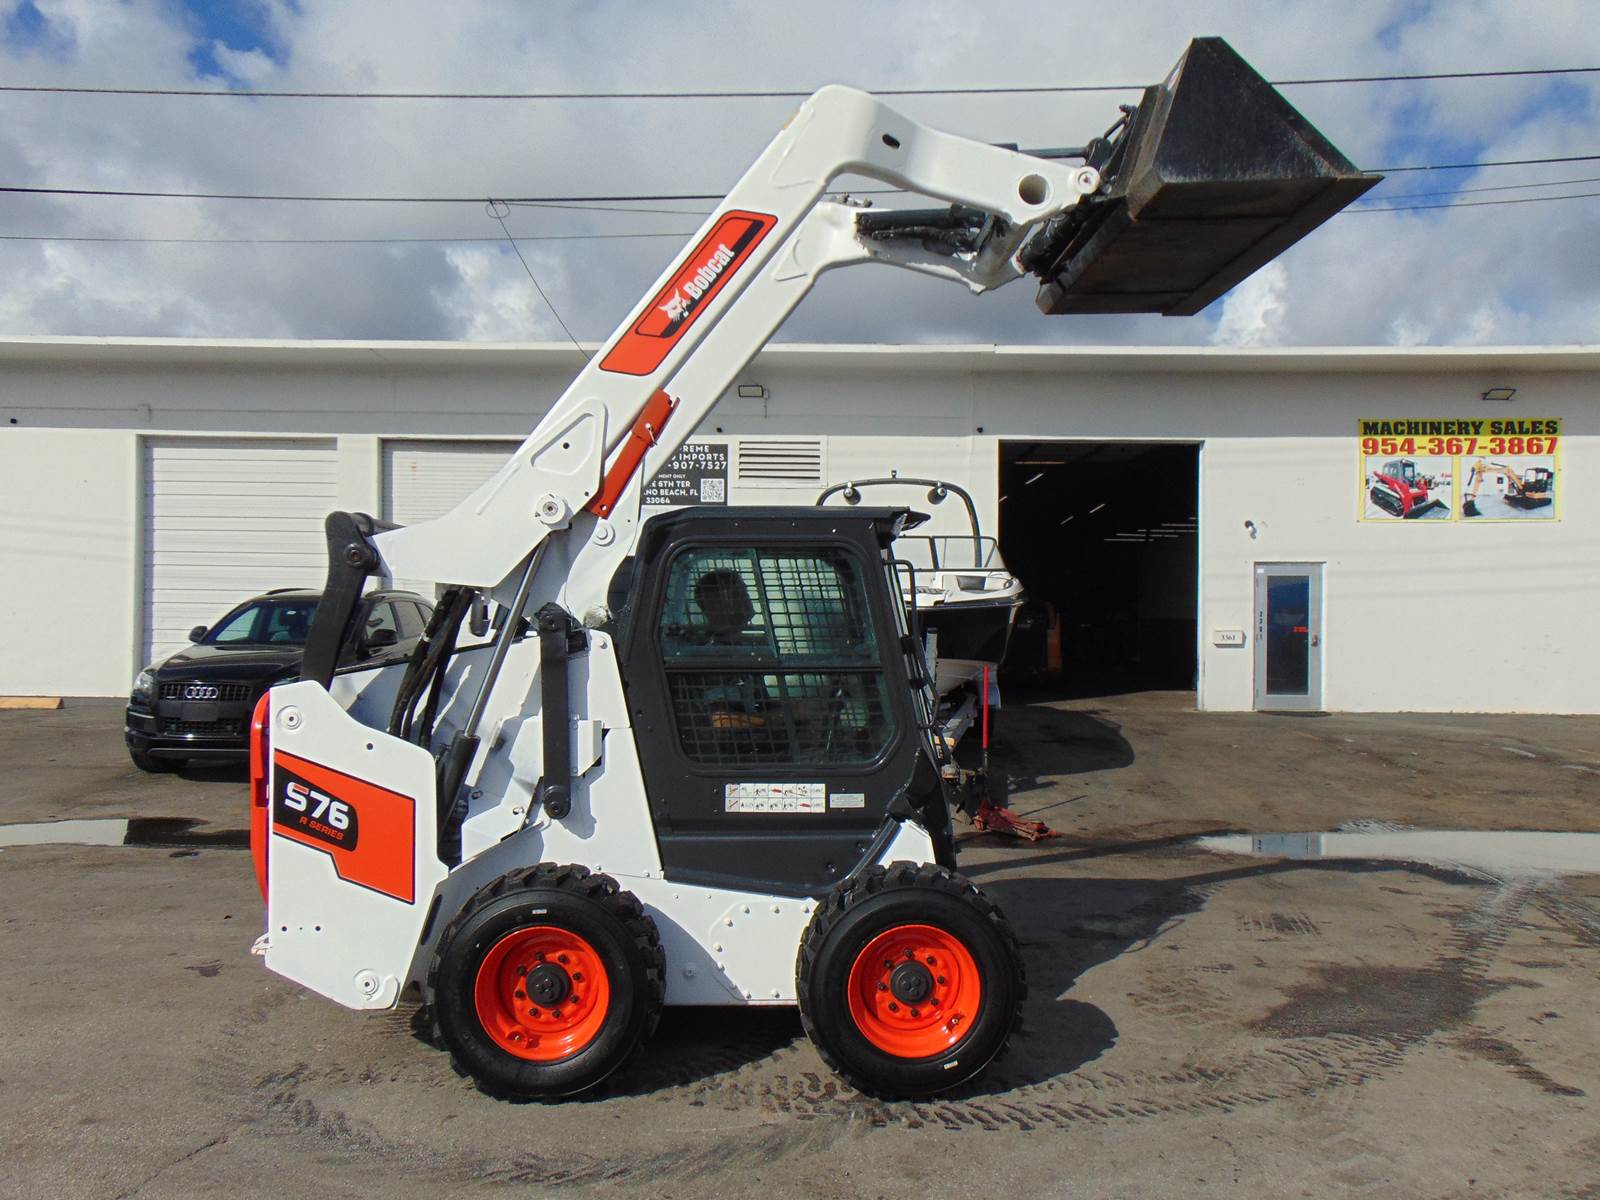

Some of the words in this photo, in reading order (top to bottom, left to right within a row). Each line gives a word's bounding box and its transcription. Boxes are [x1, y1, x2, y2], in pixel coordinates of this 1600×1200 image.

[684, 243, 736, 300] Bobcat
[1362, 420, 1484, 436] MACHINERY
[1490, 420, 1558, 436] SALES
[679, 445, 710, 453] REME
[1362, 437, 1558, 455] 954-367-3867
[679, 453, 725, 461] IMPORTS
[667, 461, 727, 470] -907-7527
[676, 480, 691, 488] TER
[689, 488, 699, 496] FL
[284, 781, 350, 830] S76
[309, 821, 345, 841] SERIES
